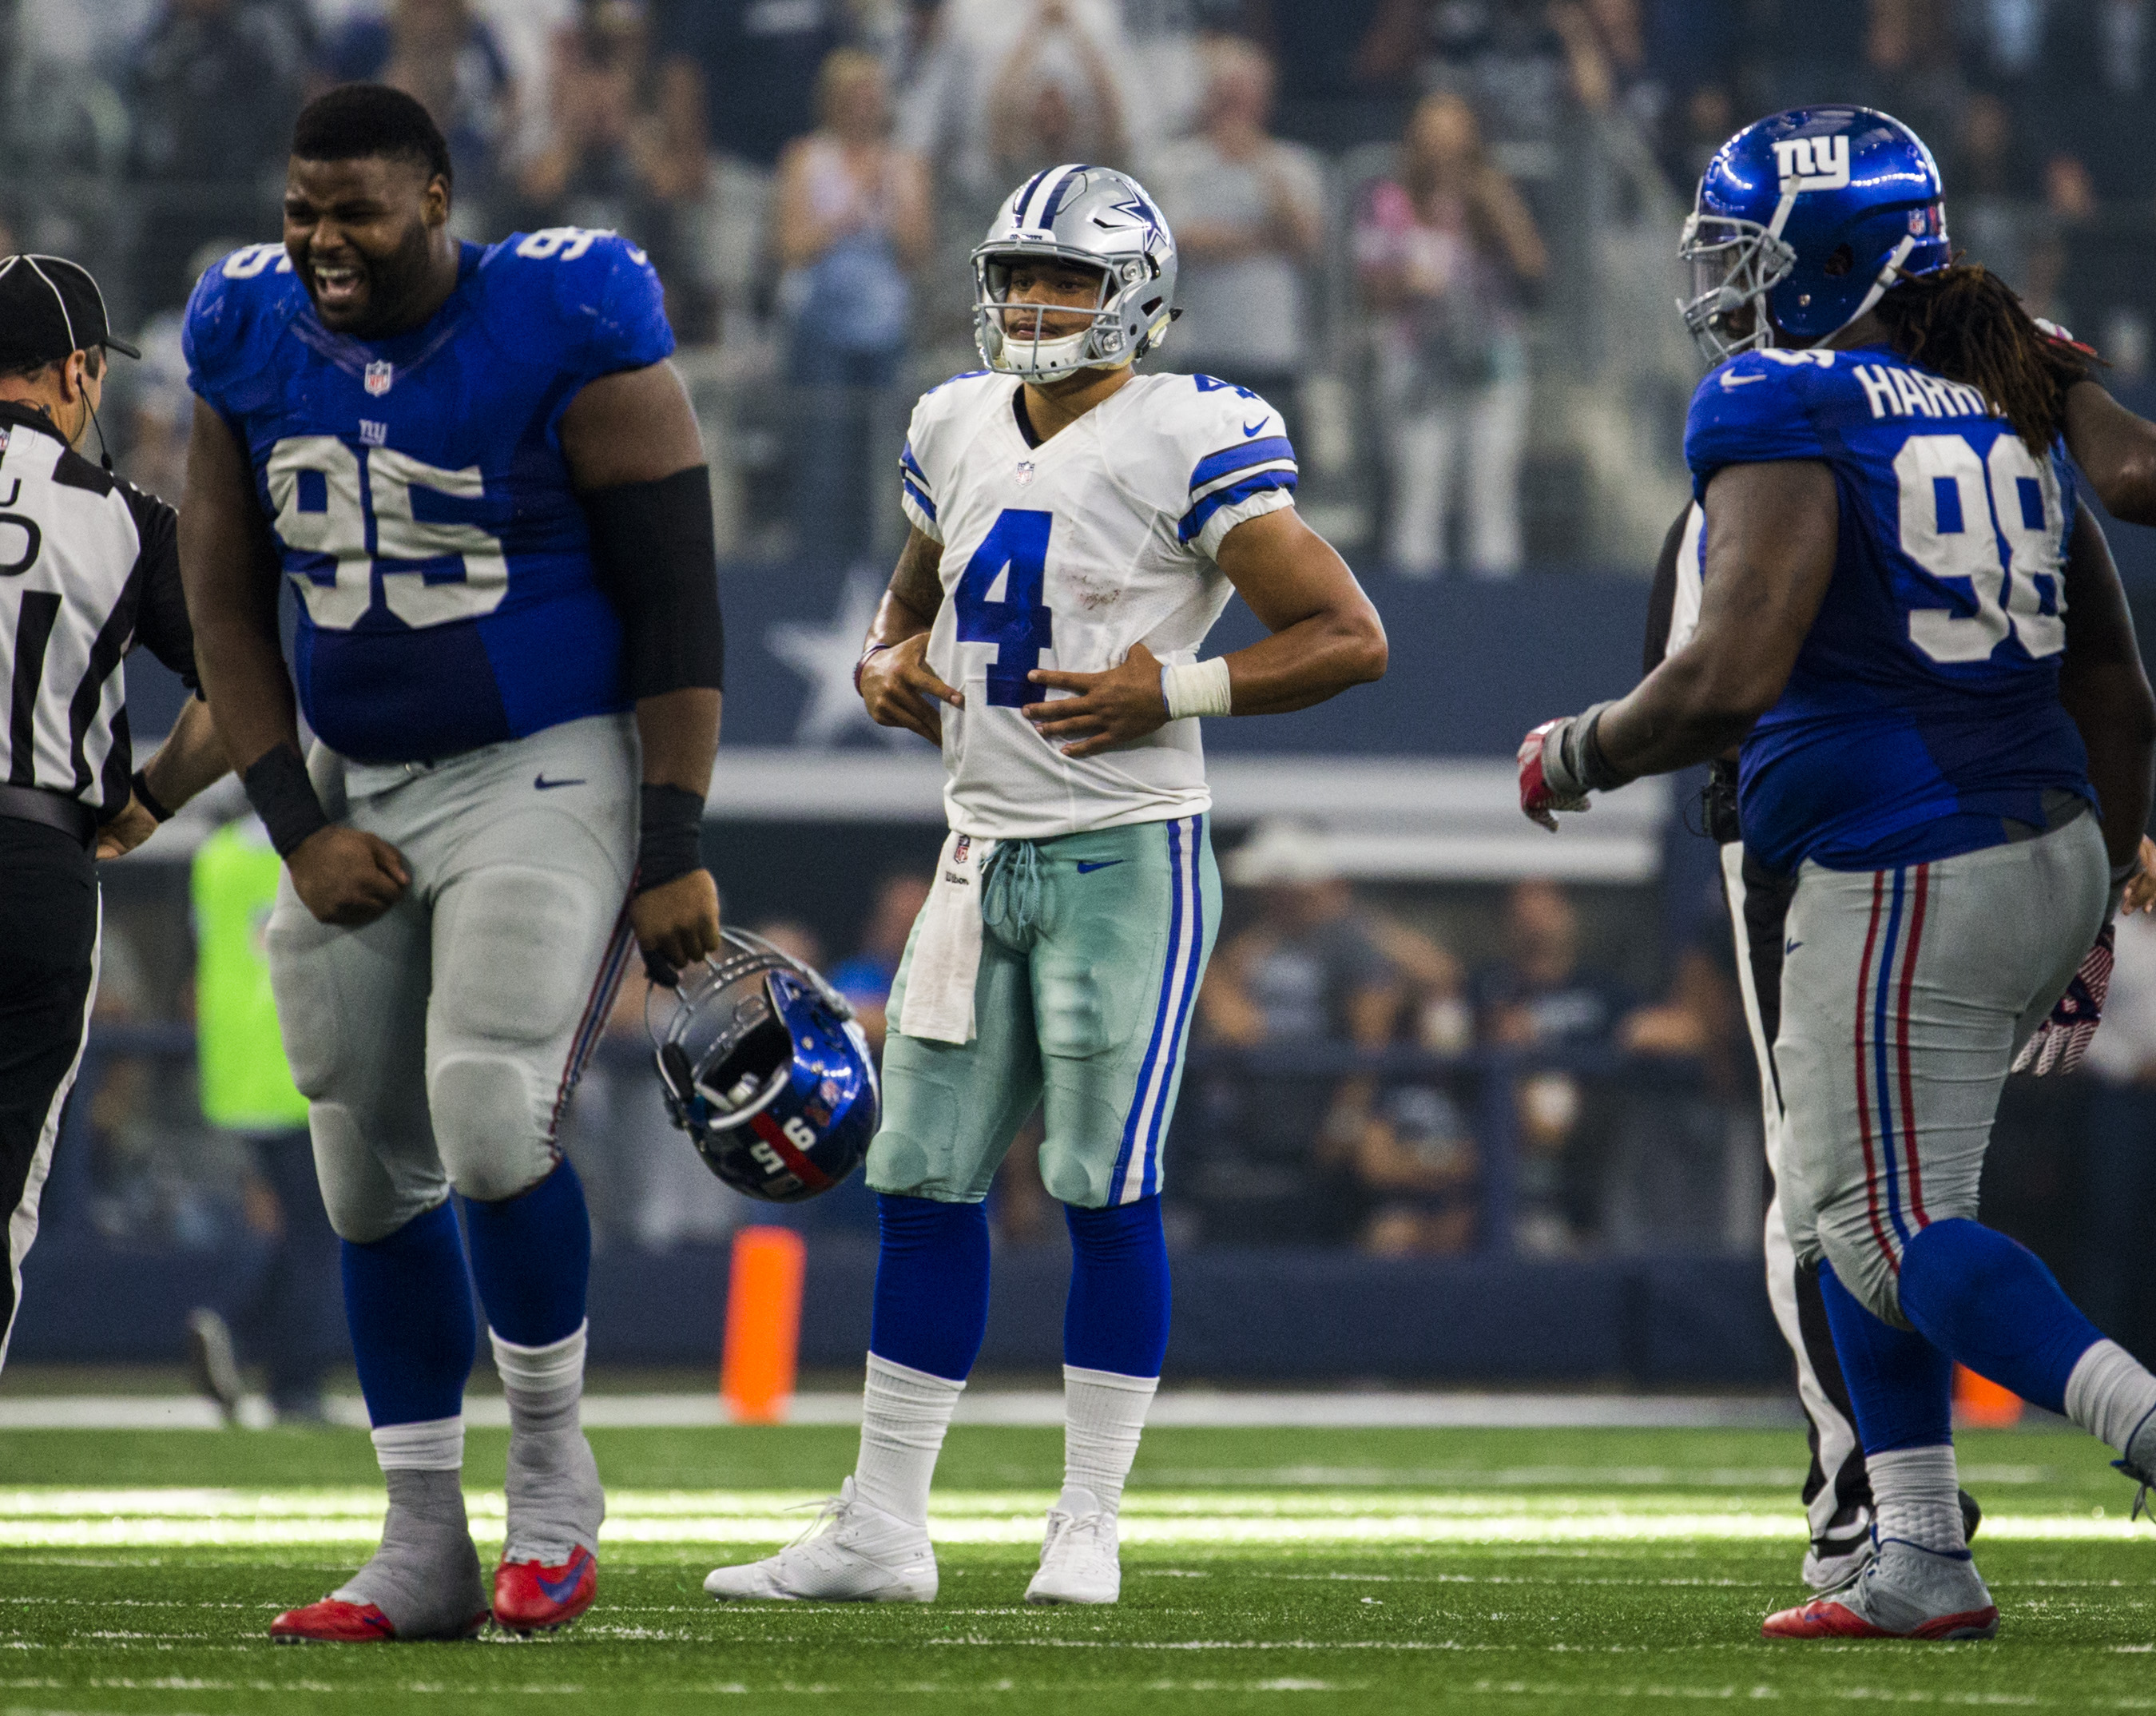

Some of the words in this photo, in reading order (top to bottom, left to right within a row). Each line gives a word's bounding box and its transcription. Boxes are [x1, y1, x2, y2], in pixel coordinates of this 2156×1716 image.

[266, 435, 509, 631] 95
[954, 508, 1053, 708] 4
[1892, 433, 2068, 663] 98
[749, 1116, 816, 1175] 95
